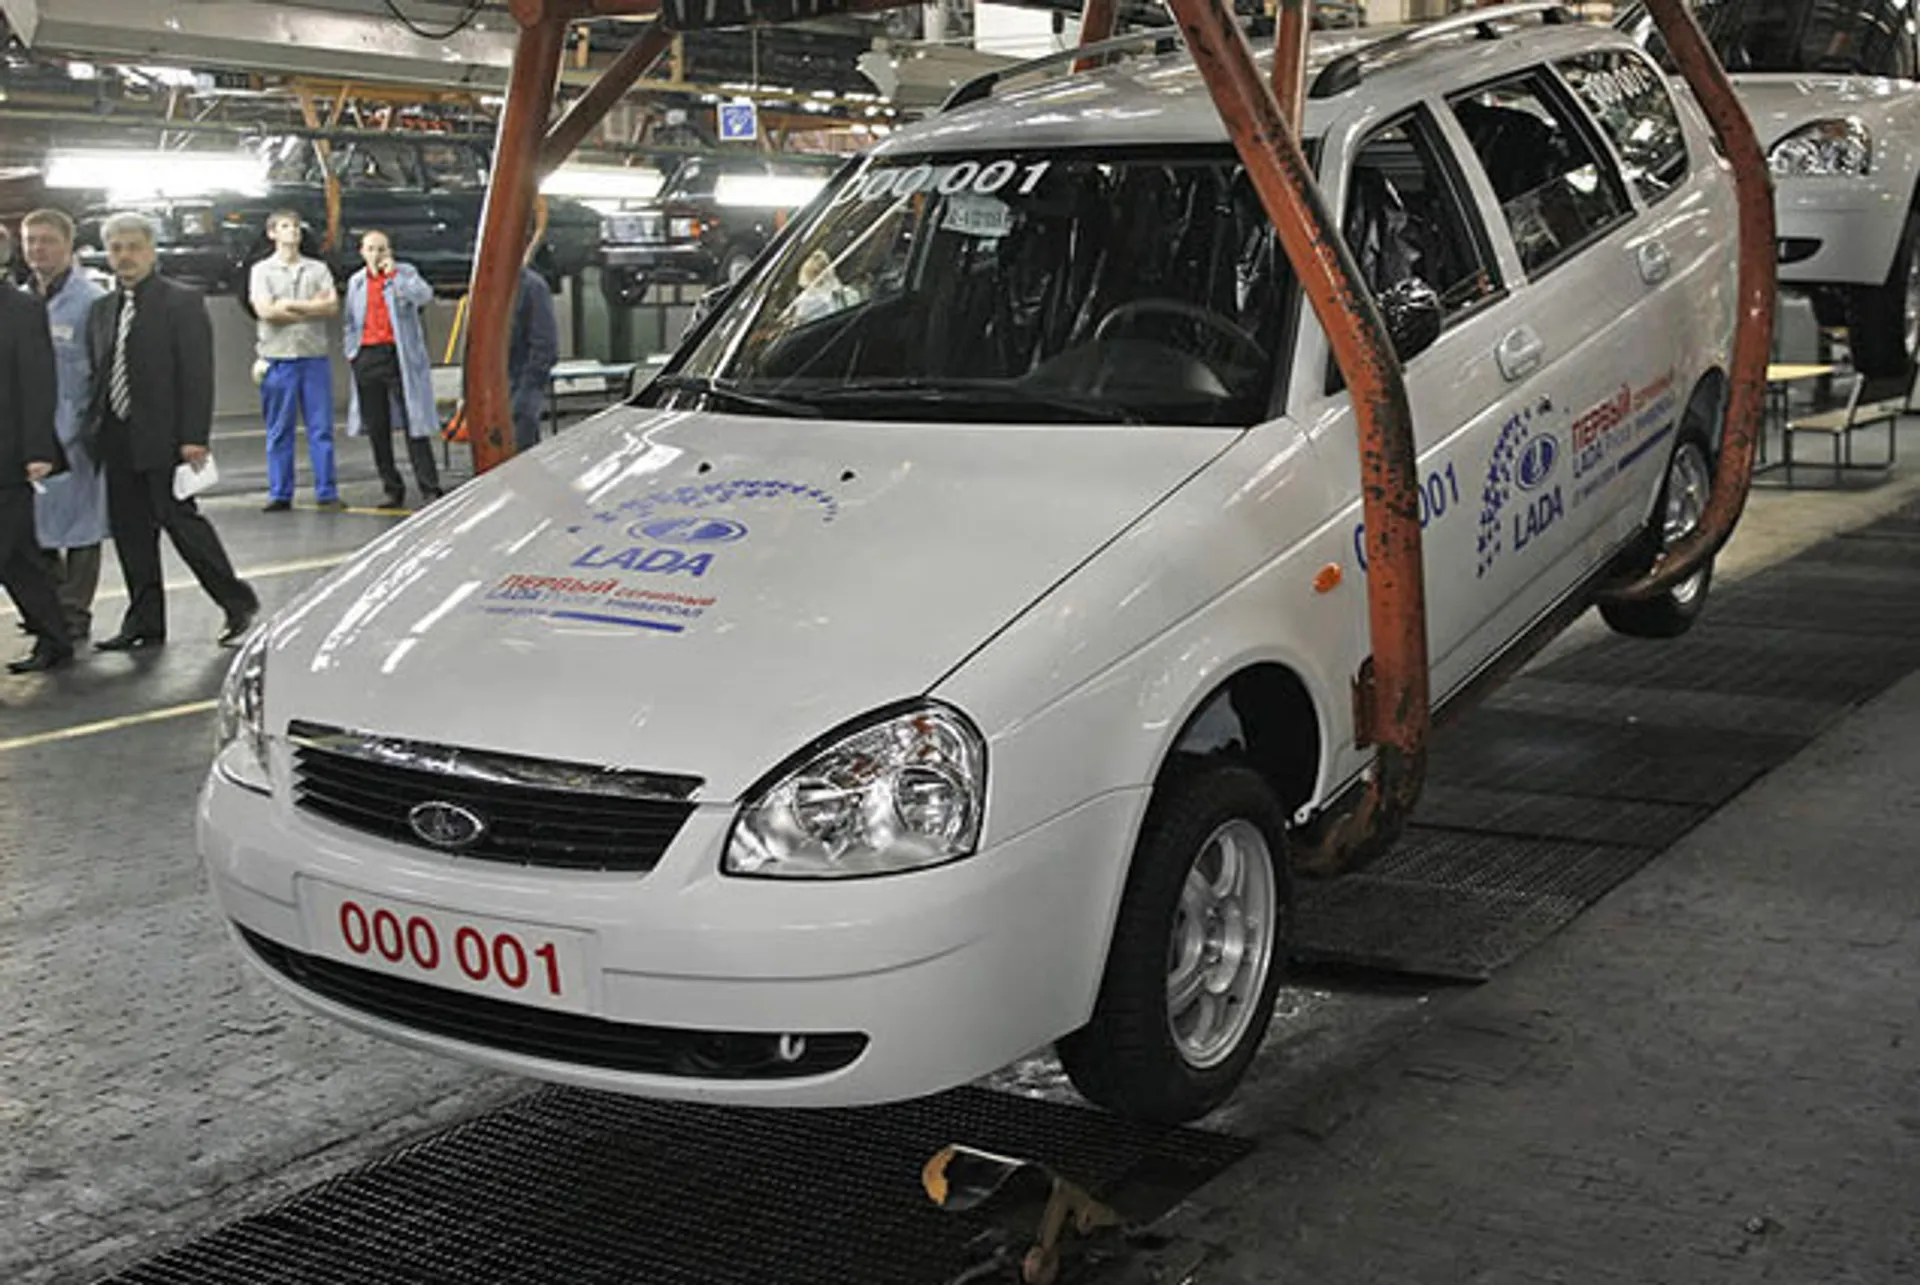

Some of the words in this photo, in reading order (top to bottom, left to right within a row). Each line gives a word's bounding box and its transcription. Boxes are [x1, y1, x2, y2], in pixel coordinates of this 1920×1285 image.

[938, 160, 1051, 195] 001
[1514, 485, 1564, 552] LADA
[571, 545, 715, 577] LADA
[340, 901, 440, 970] 000
[455, 926, 561, 996] 001
